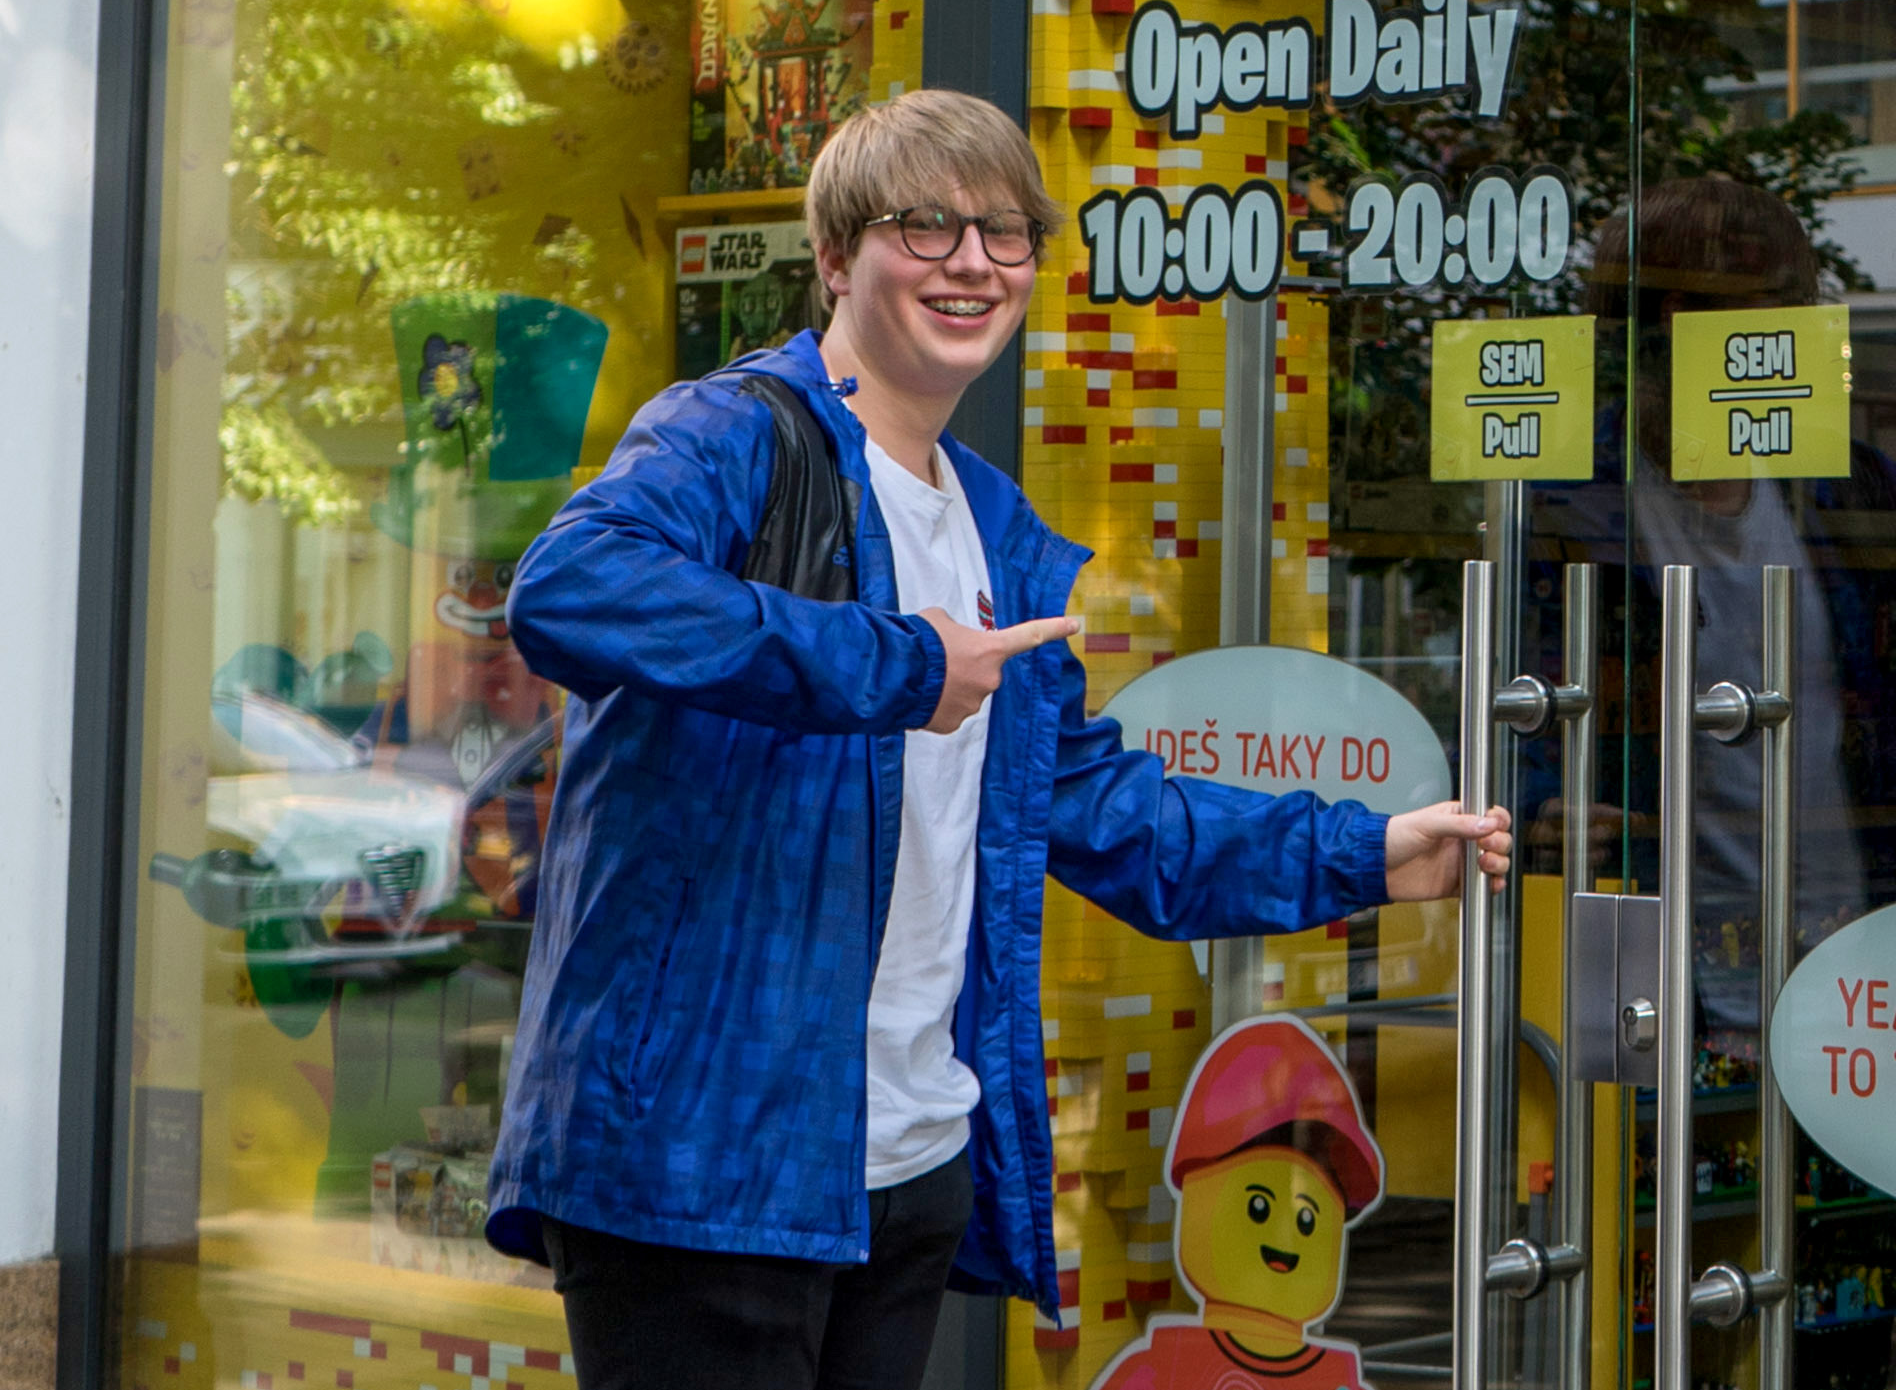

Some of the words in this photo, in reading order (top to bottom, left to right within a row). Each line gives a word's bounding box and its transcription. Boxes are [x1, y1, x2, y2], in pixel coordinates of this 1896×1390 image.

[1129, 6, 1311, 134] Open
[710, 231, 767, 251] STAR
[1083, 187, 1281, 298] 10:00
[1346, 172, 1573, 288] 20:00
[710, 250, 767, 271] WARS
[1479, 340, 1545, 387] SEM
[1725, 332, 1796, 380] SEM
[1482, 413, 1540, 458] Pull
[1729, 408, 1792, 455] Pull
[1235, 731, 1327, 781] TAKY
[1341, 736, 1391, 783] DO
[1822, 1044, 1878, 1098] TO
